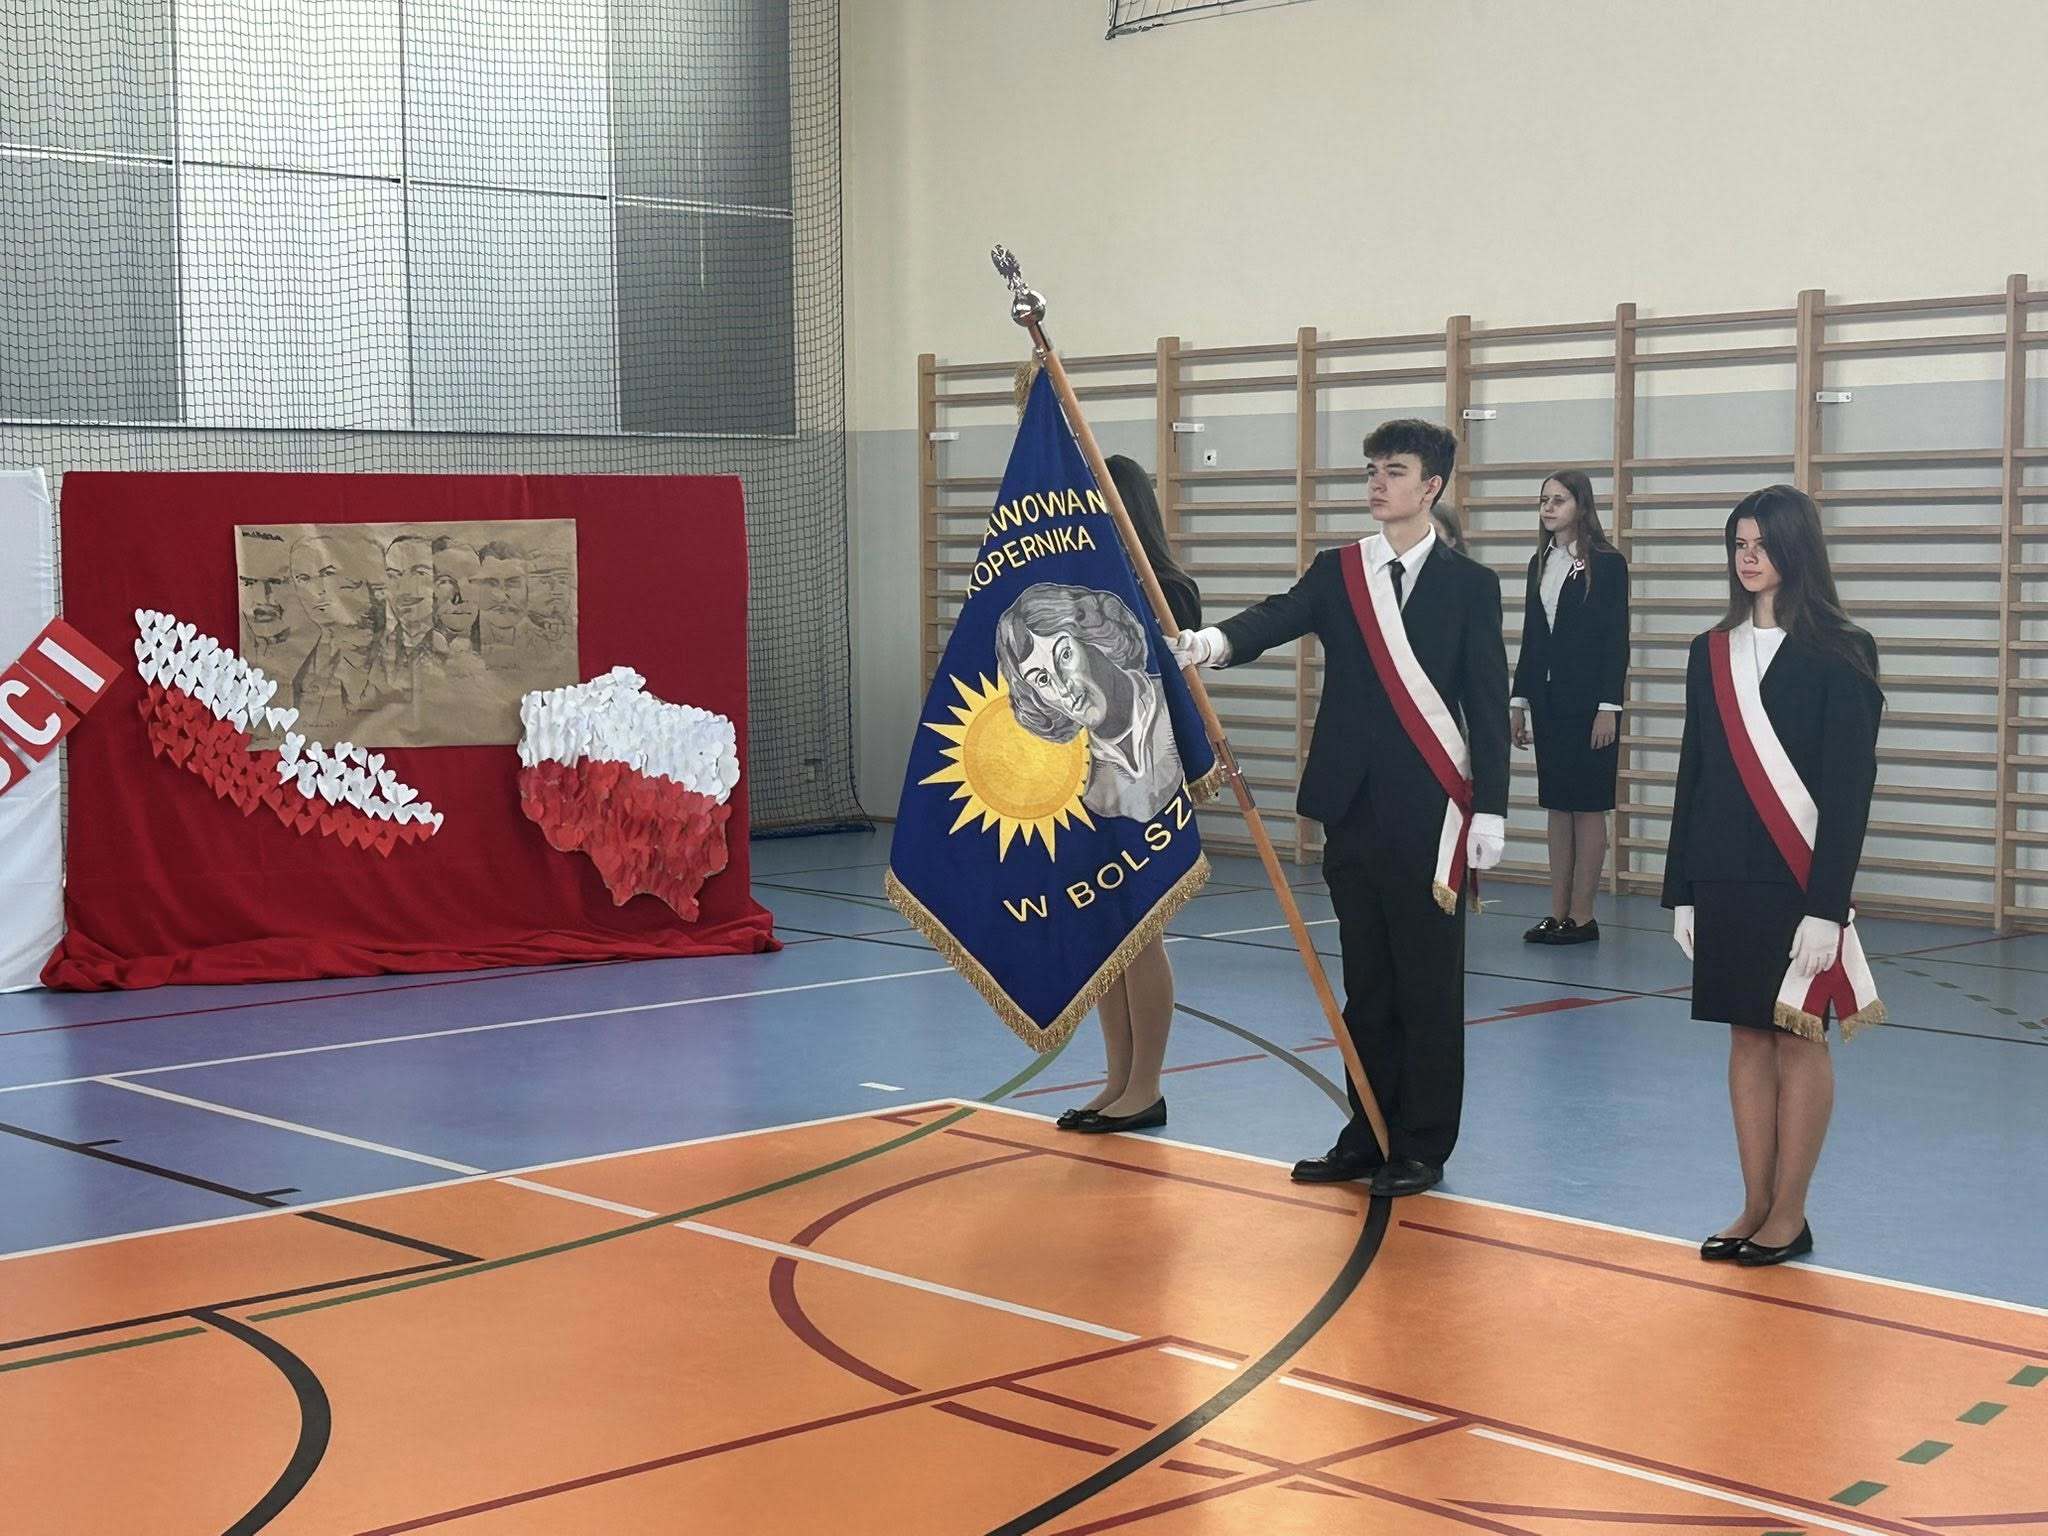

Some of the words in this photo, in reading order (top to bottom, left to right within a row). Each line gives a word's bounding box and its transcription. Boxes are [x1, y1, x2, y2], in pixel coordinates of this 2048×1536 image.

[0, 637, 105, 790] CI
[1003, 895, 1048, 922] W
[1066, 780, 1193, 909] BOLSZ
